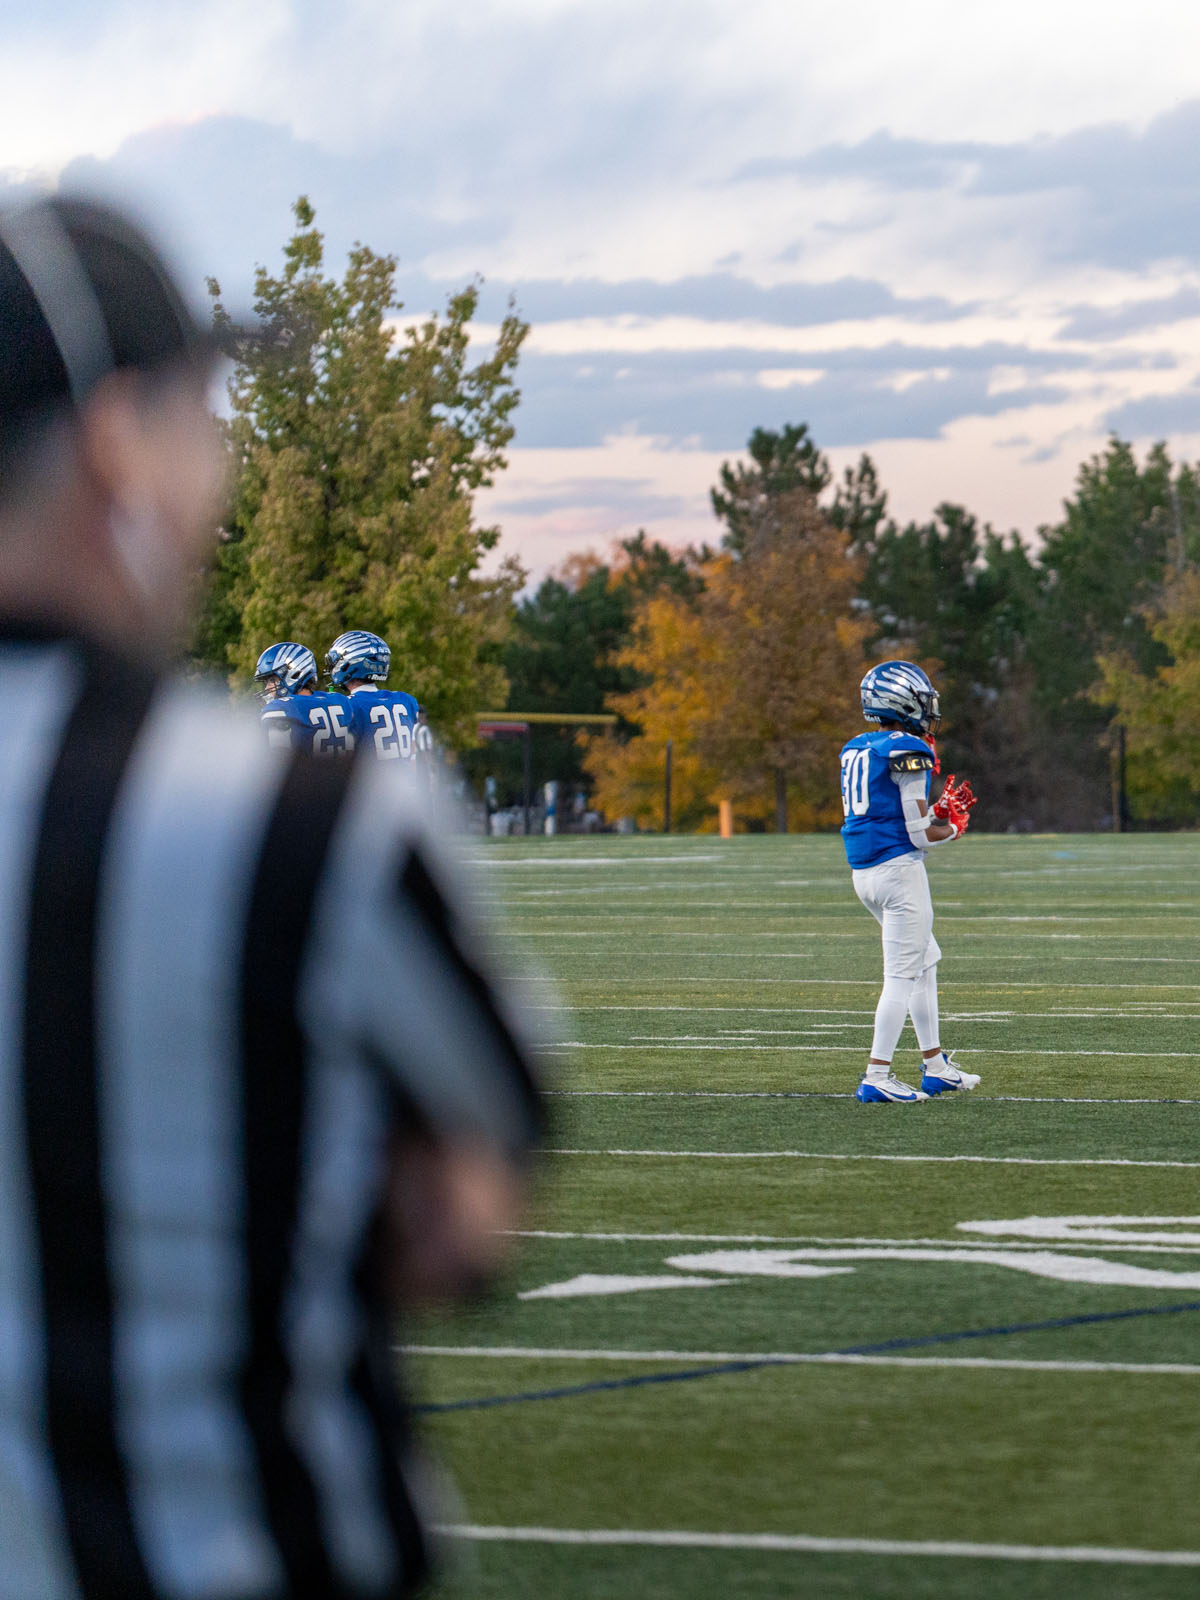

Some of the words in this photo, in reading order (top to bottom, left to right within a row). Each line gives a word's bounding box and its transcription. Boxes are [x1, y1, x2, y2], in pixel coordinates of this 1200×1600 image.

[309, 705, 355, 754] 25
[370, 703, 411, 760] 26
[841, 748, 871, 816] 30
